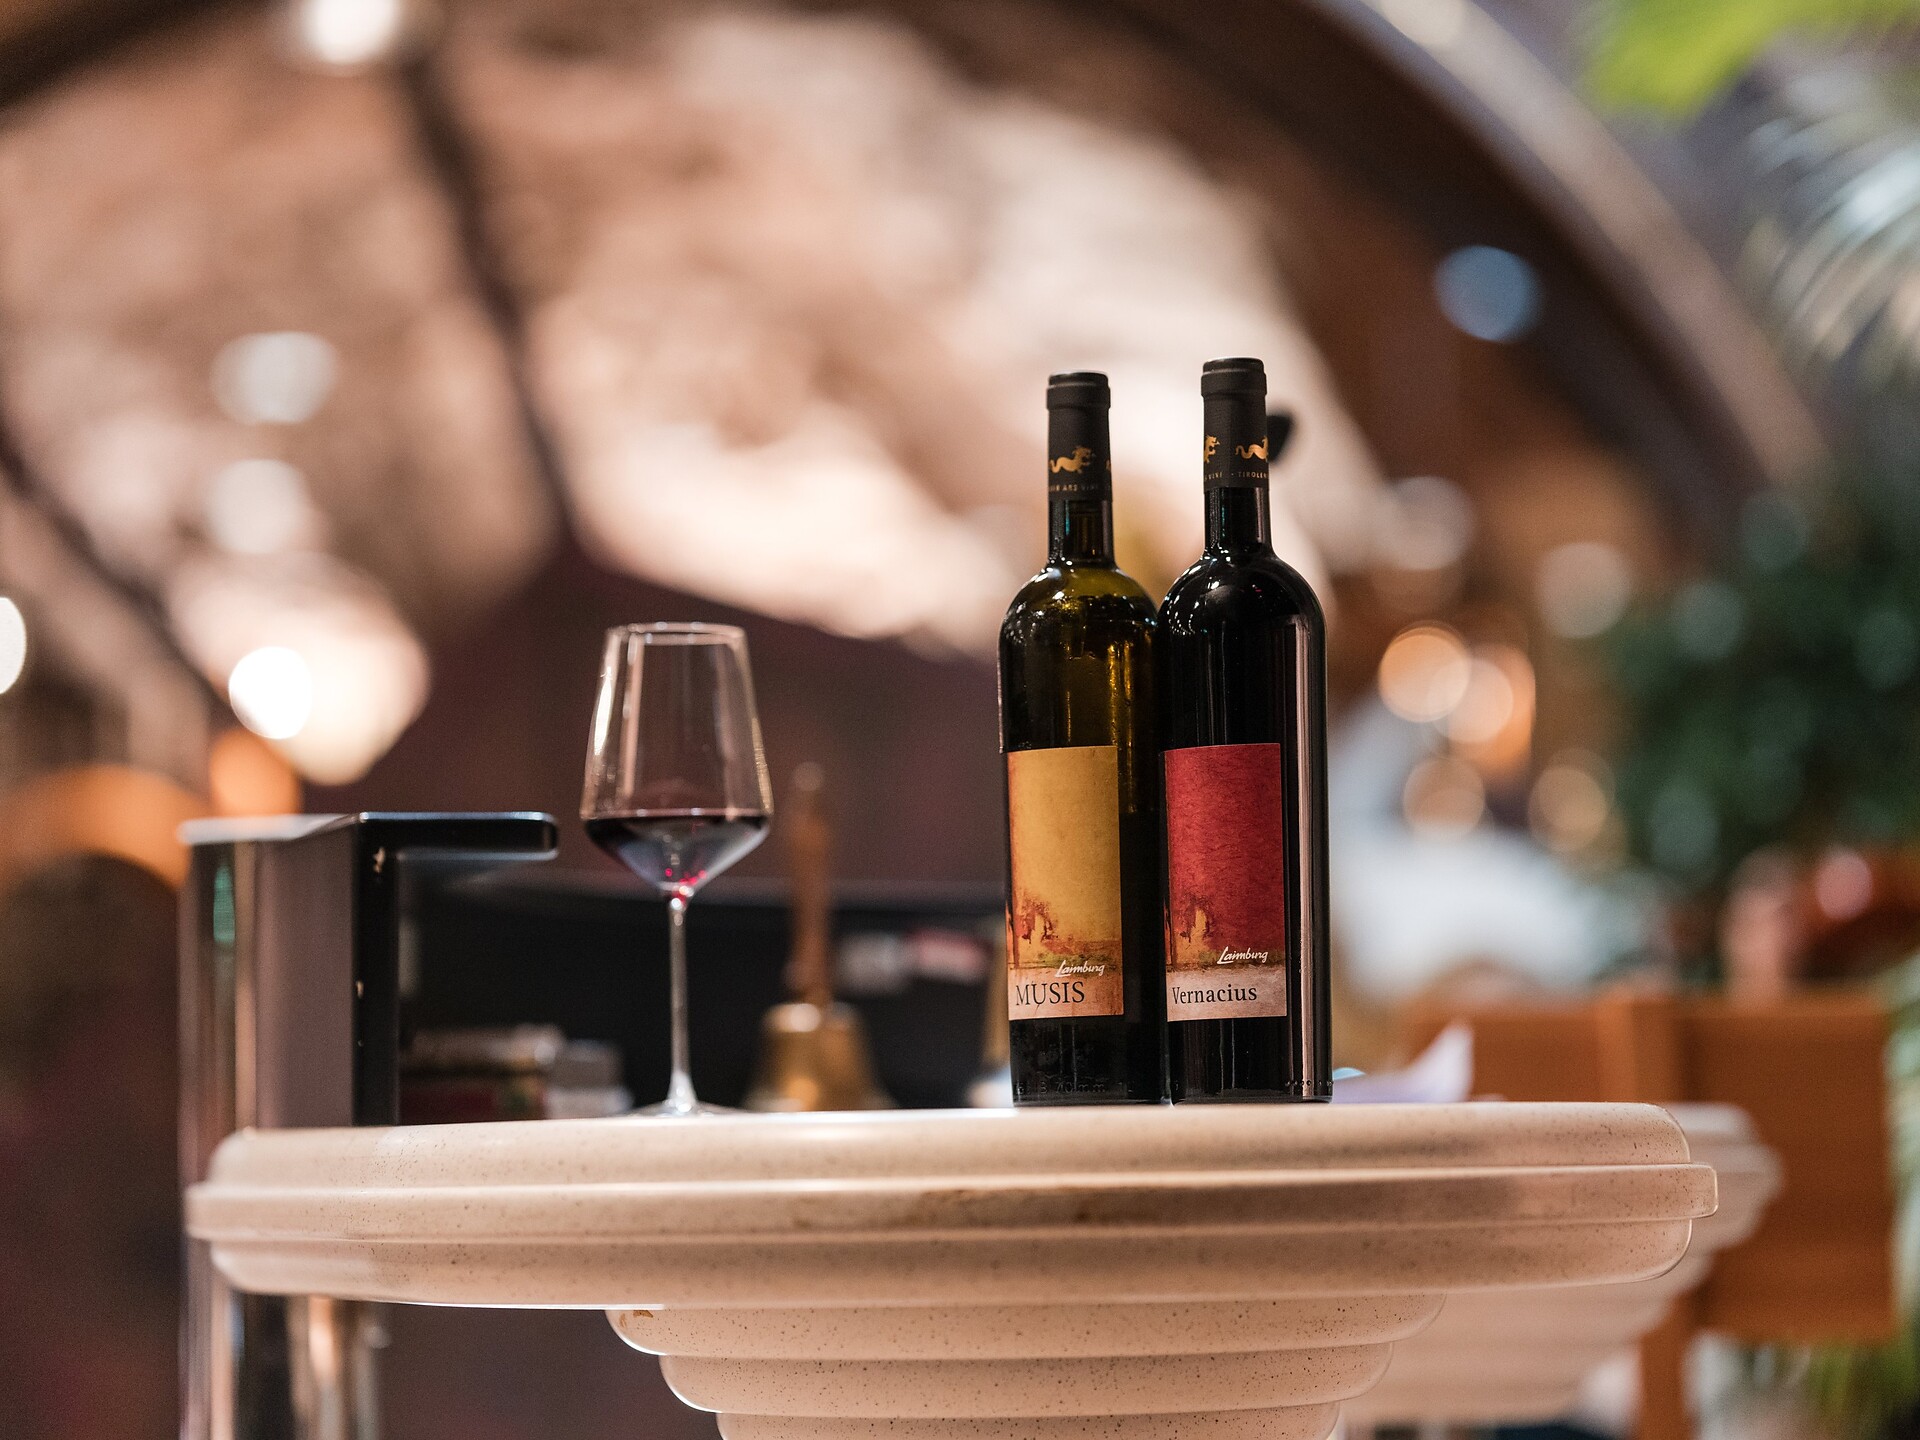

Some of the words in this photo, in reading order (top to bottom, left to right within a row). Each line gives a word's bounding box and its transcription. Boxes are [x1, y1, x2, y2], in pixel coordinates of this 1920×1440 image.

[1217, 946, 1269, 965] Laimburg
[1054, 959, 1106, 978] Laimburg
[1016, 981, 1085, 1006] MUSIS
[1172, 983, 1258, 1004] Vernacius
